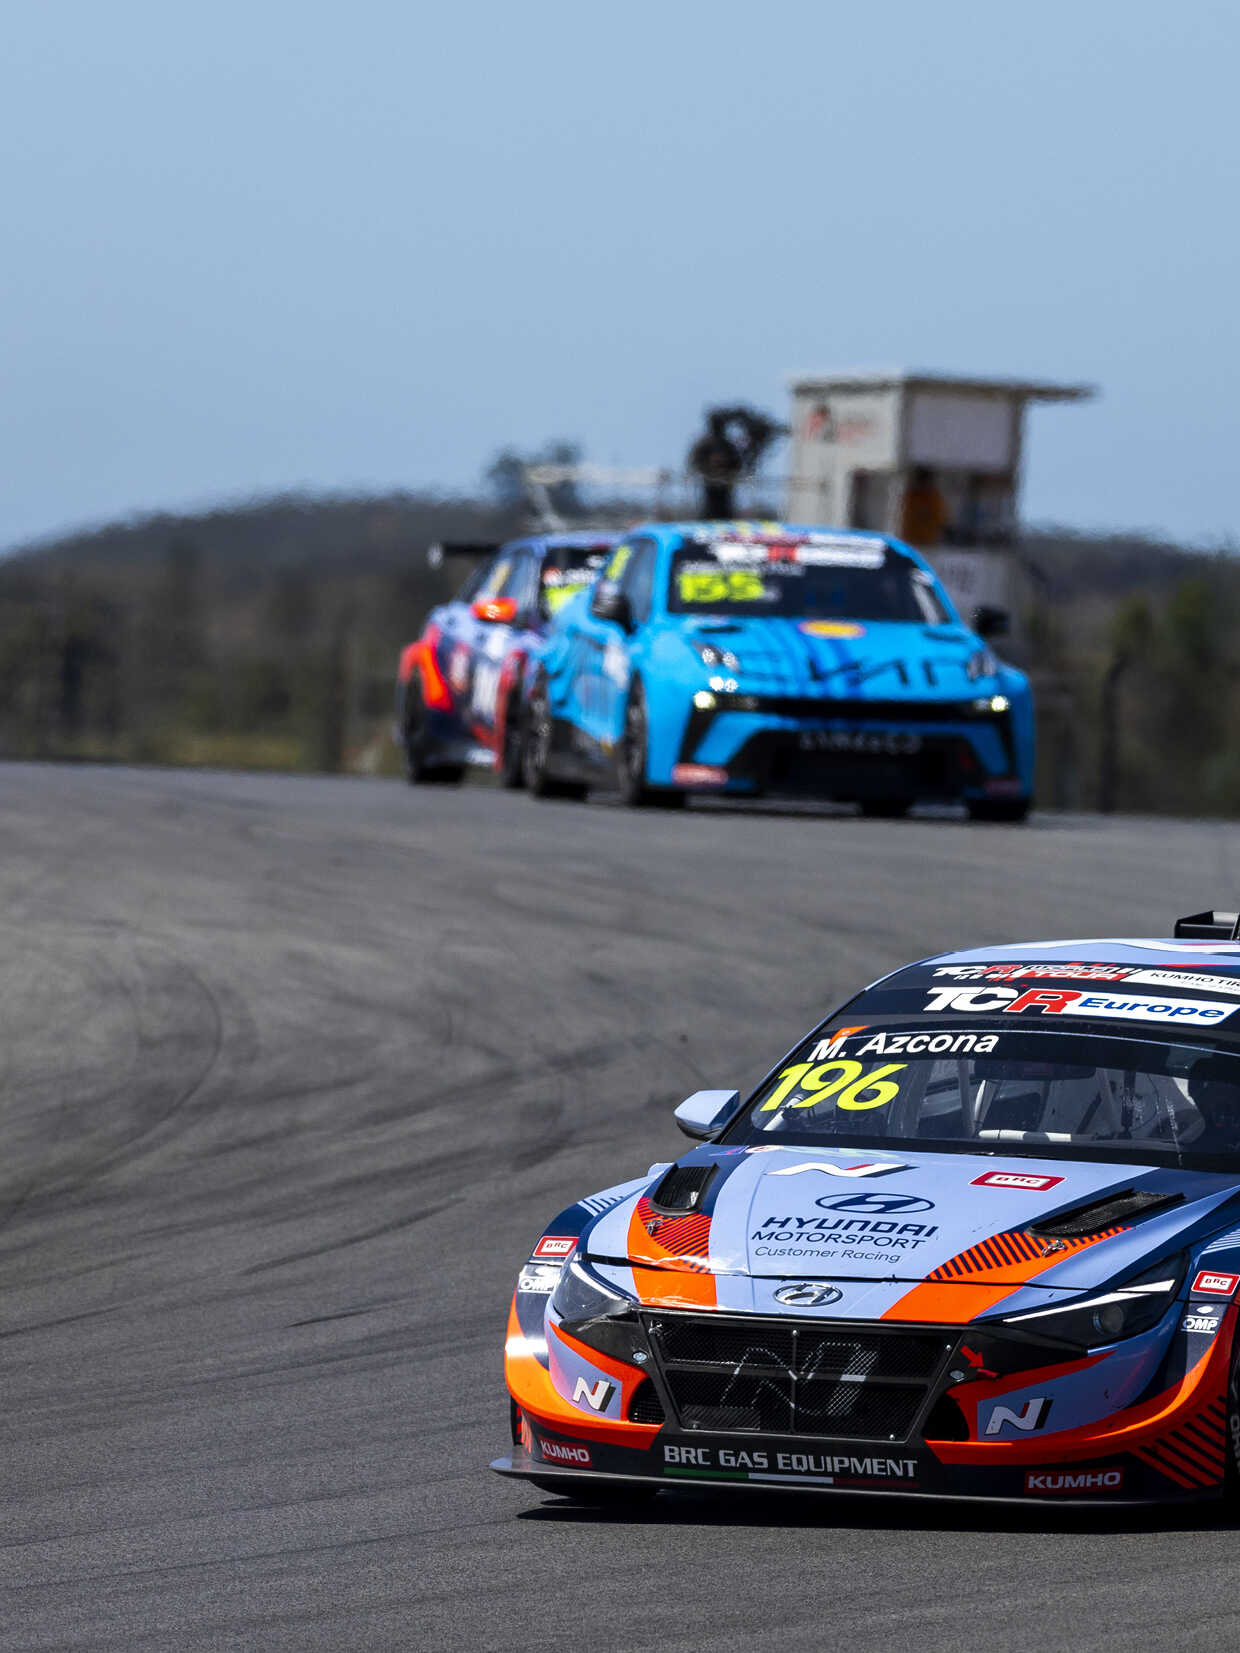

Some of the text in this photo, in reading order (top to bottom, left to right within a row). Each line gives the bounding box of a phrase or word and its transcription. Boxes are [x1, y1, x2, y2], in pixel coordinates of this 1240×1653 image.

[1151, 972, 1213, 983] KUMHO
[923, 986, 1226, 1019] TCR Europe
[807, 1032, 1001, 1062] M. Azcona
[759, 1059, 909, 1112] 196
[761, 1216, 940, 1238] HYUNDAI
[752, 1231, 926, 1249] MOTORSPORT
[754, 1246, 901, 1264] Customer Racing
[1183, 1318, 1218, 1330] OMP
[540, 1439, 590, 1462] KUMHO
[663, 1445, 918, 1478] BRC GAS EQUIPMENT
[1028, 1471, 1121, 1489] KUMHO
